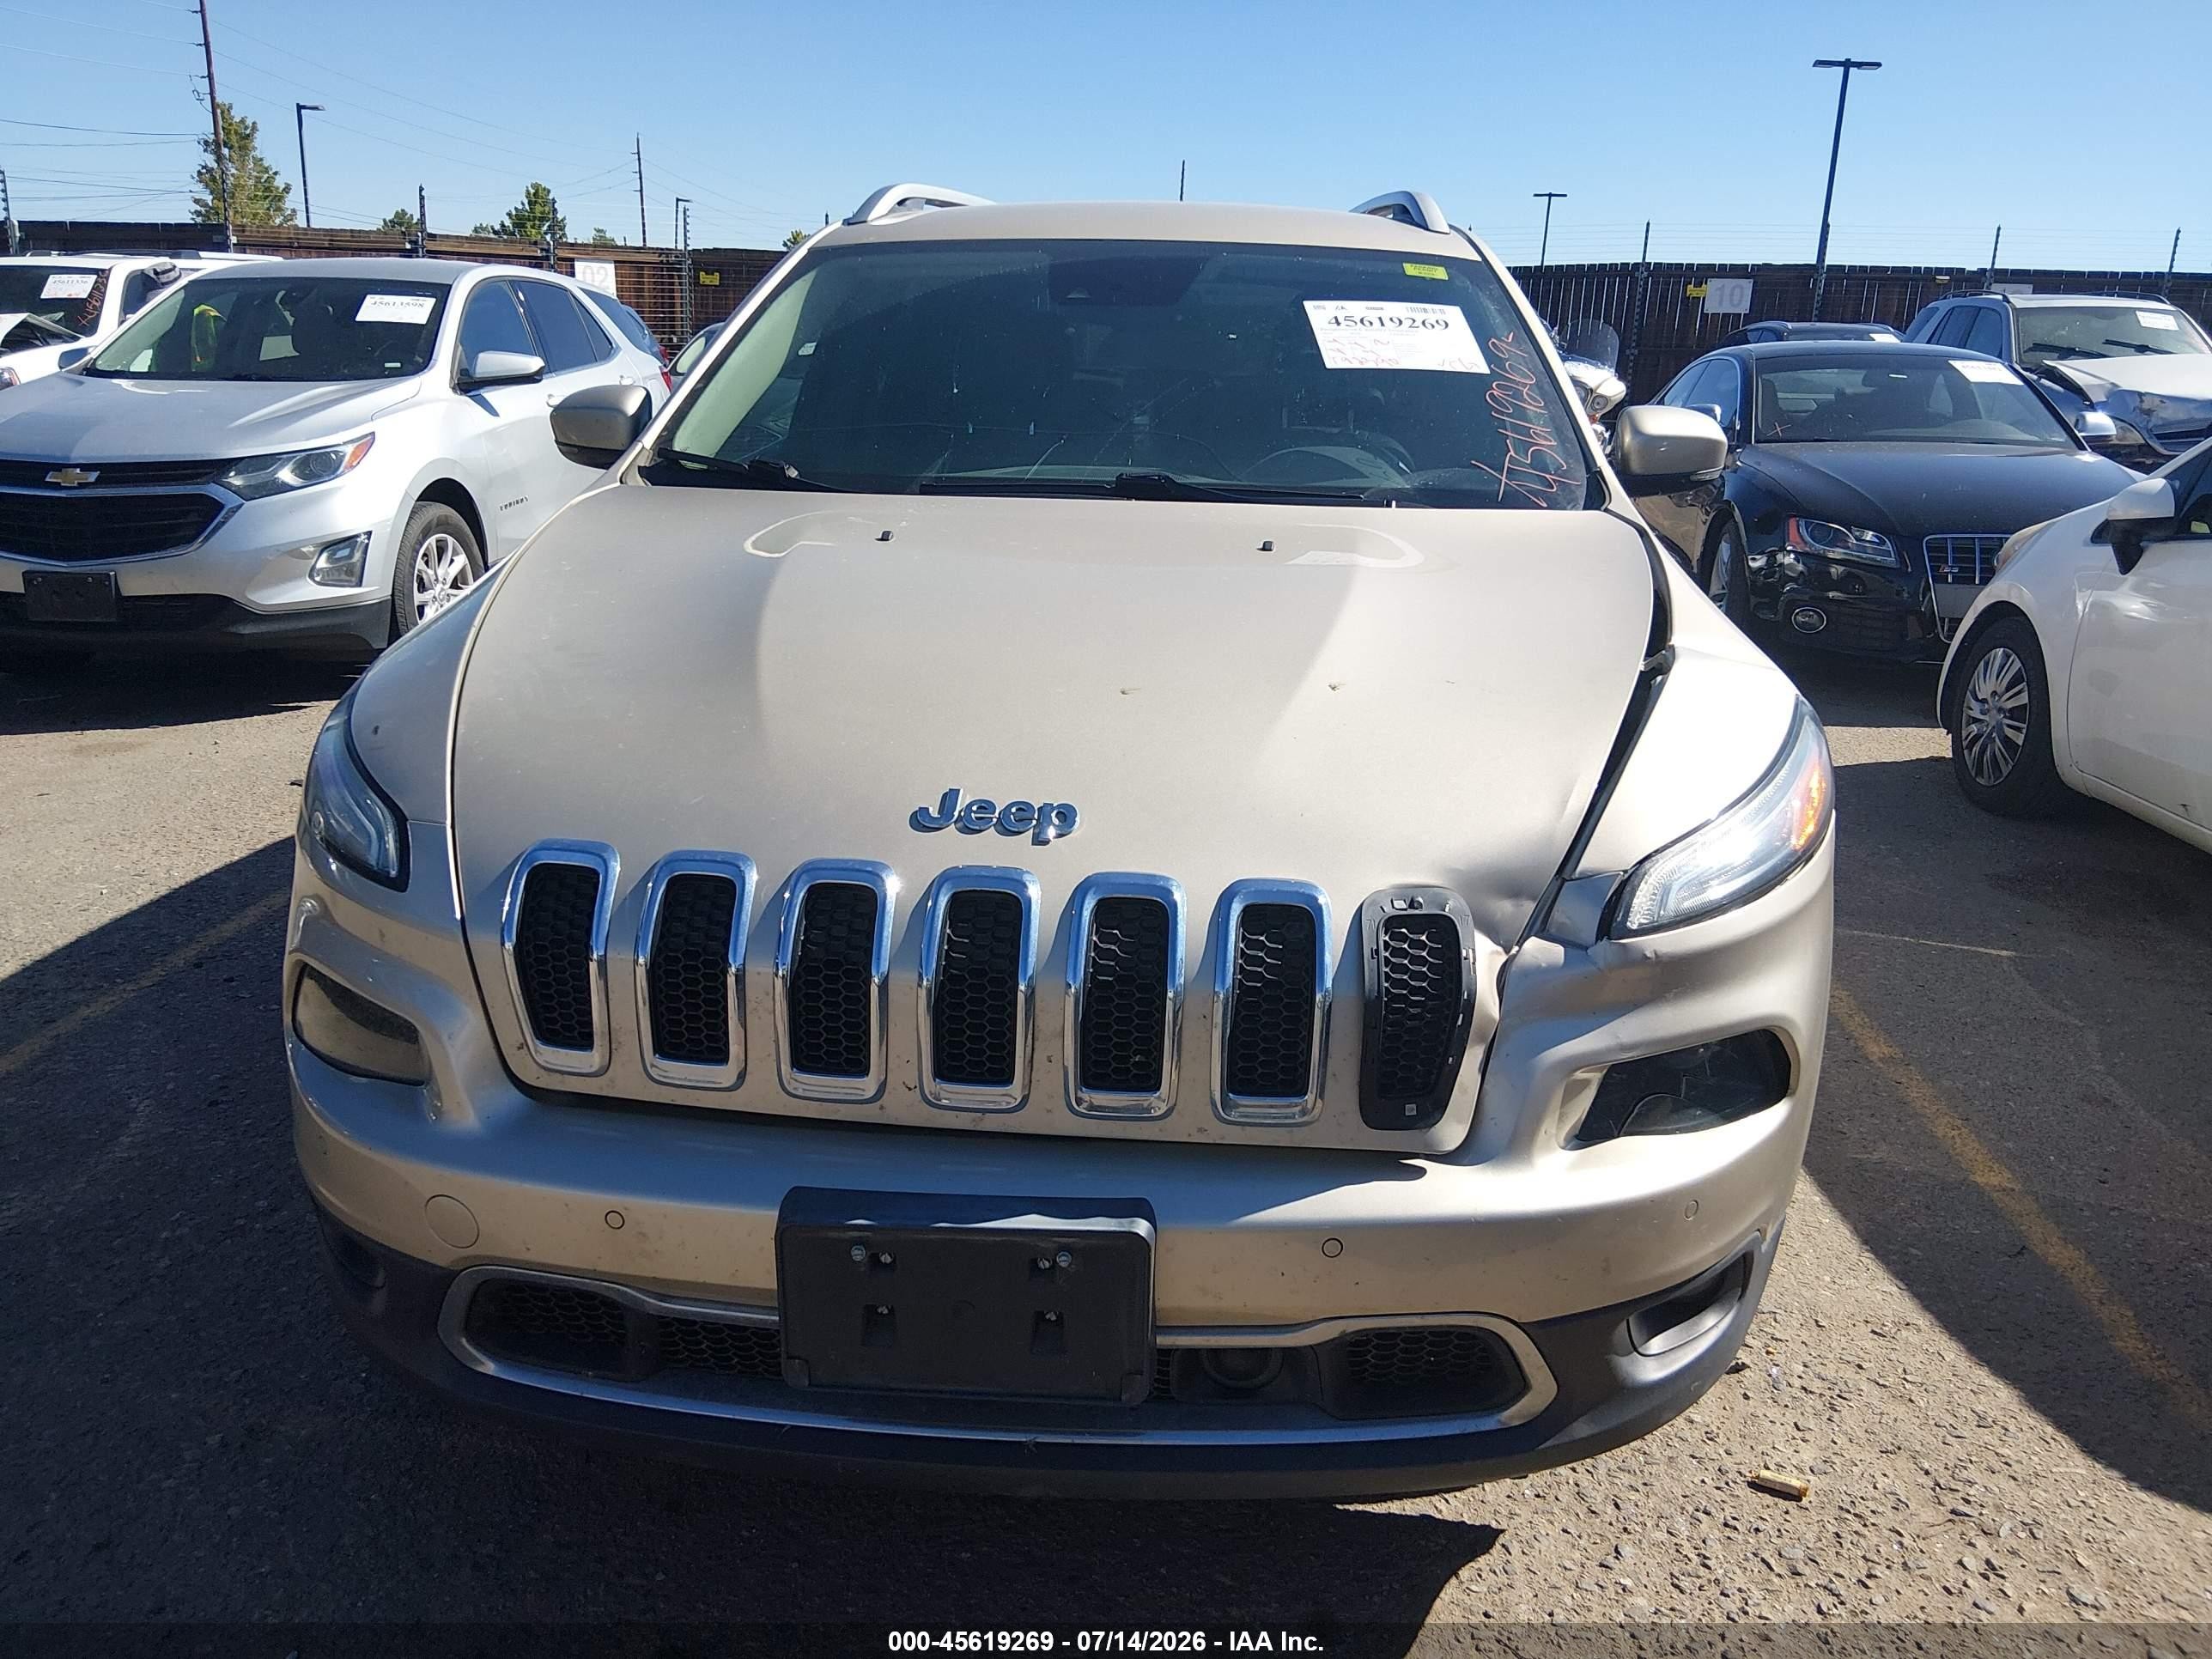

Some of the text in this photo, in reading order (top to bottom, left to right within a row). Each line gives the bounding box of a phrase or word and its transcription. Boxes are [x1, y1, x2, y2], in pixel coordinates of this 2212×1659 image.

[1715, 283, 1745, 307] 10
[1328, 315, 1449, 331] 45619269
[908, 787, 1080, 847] Jeep
